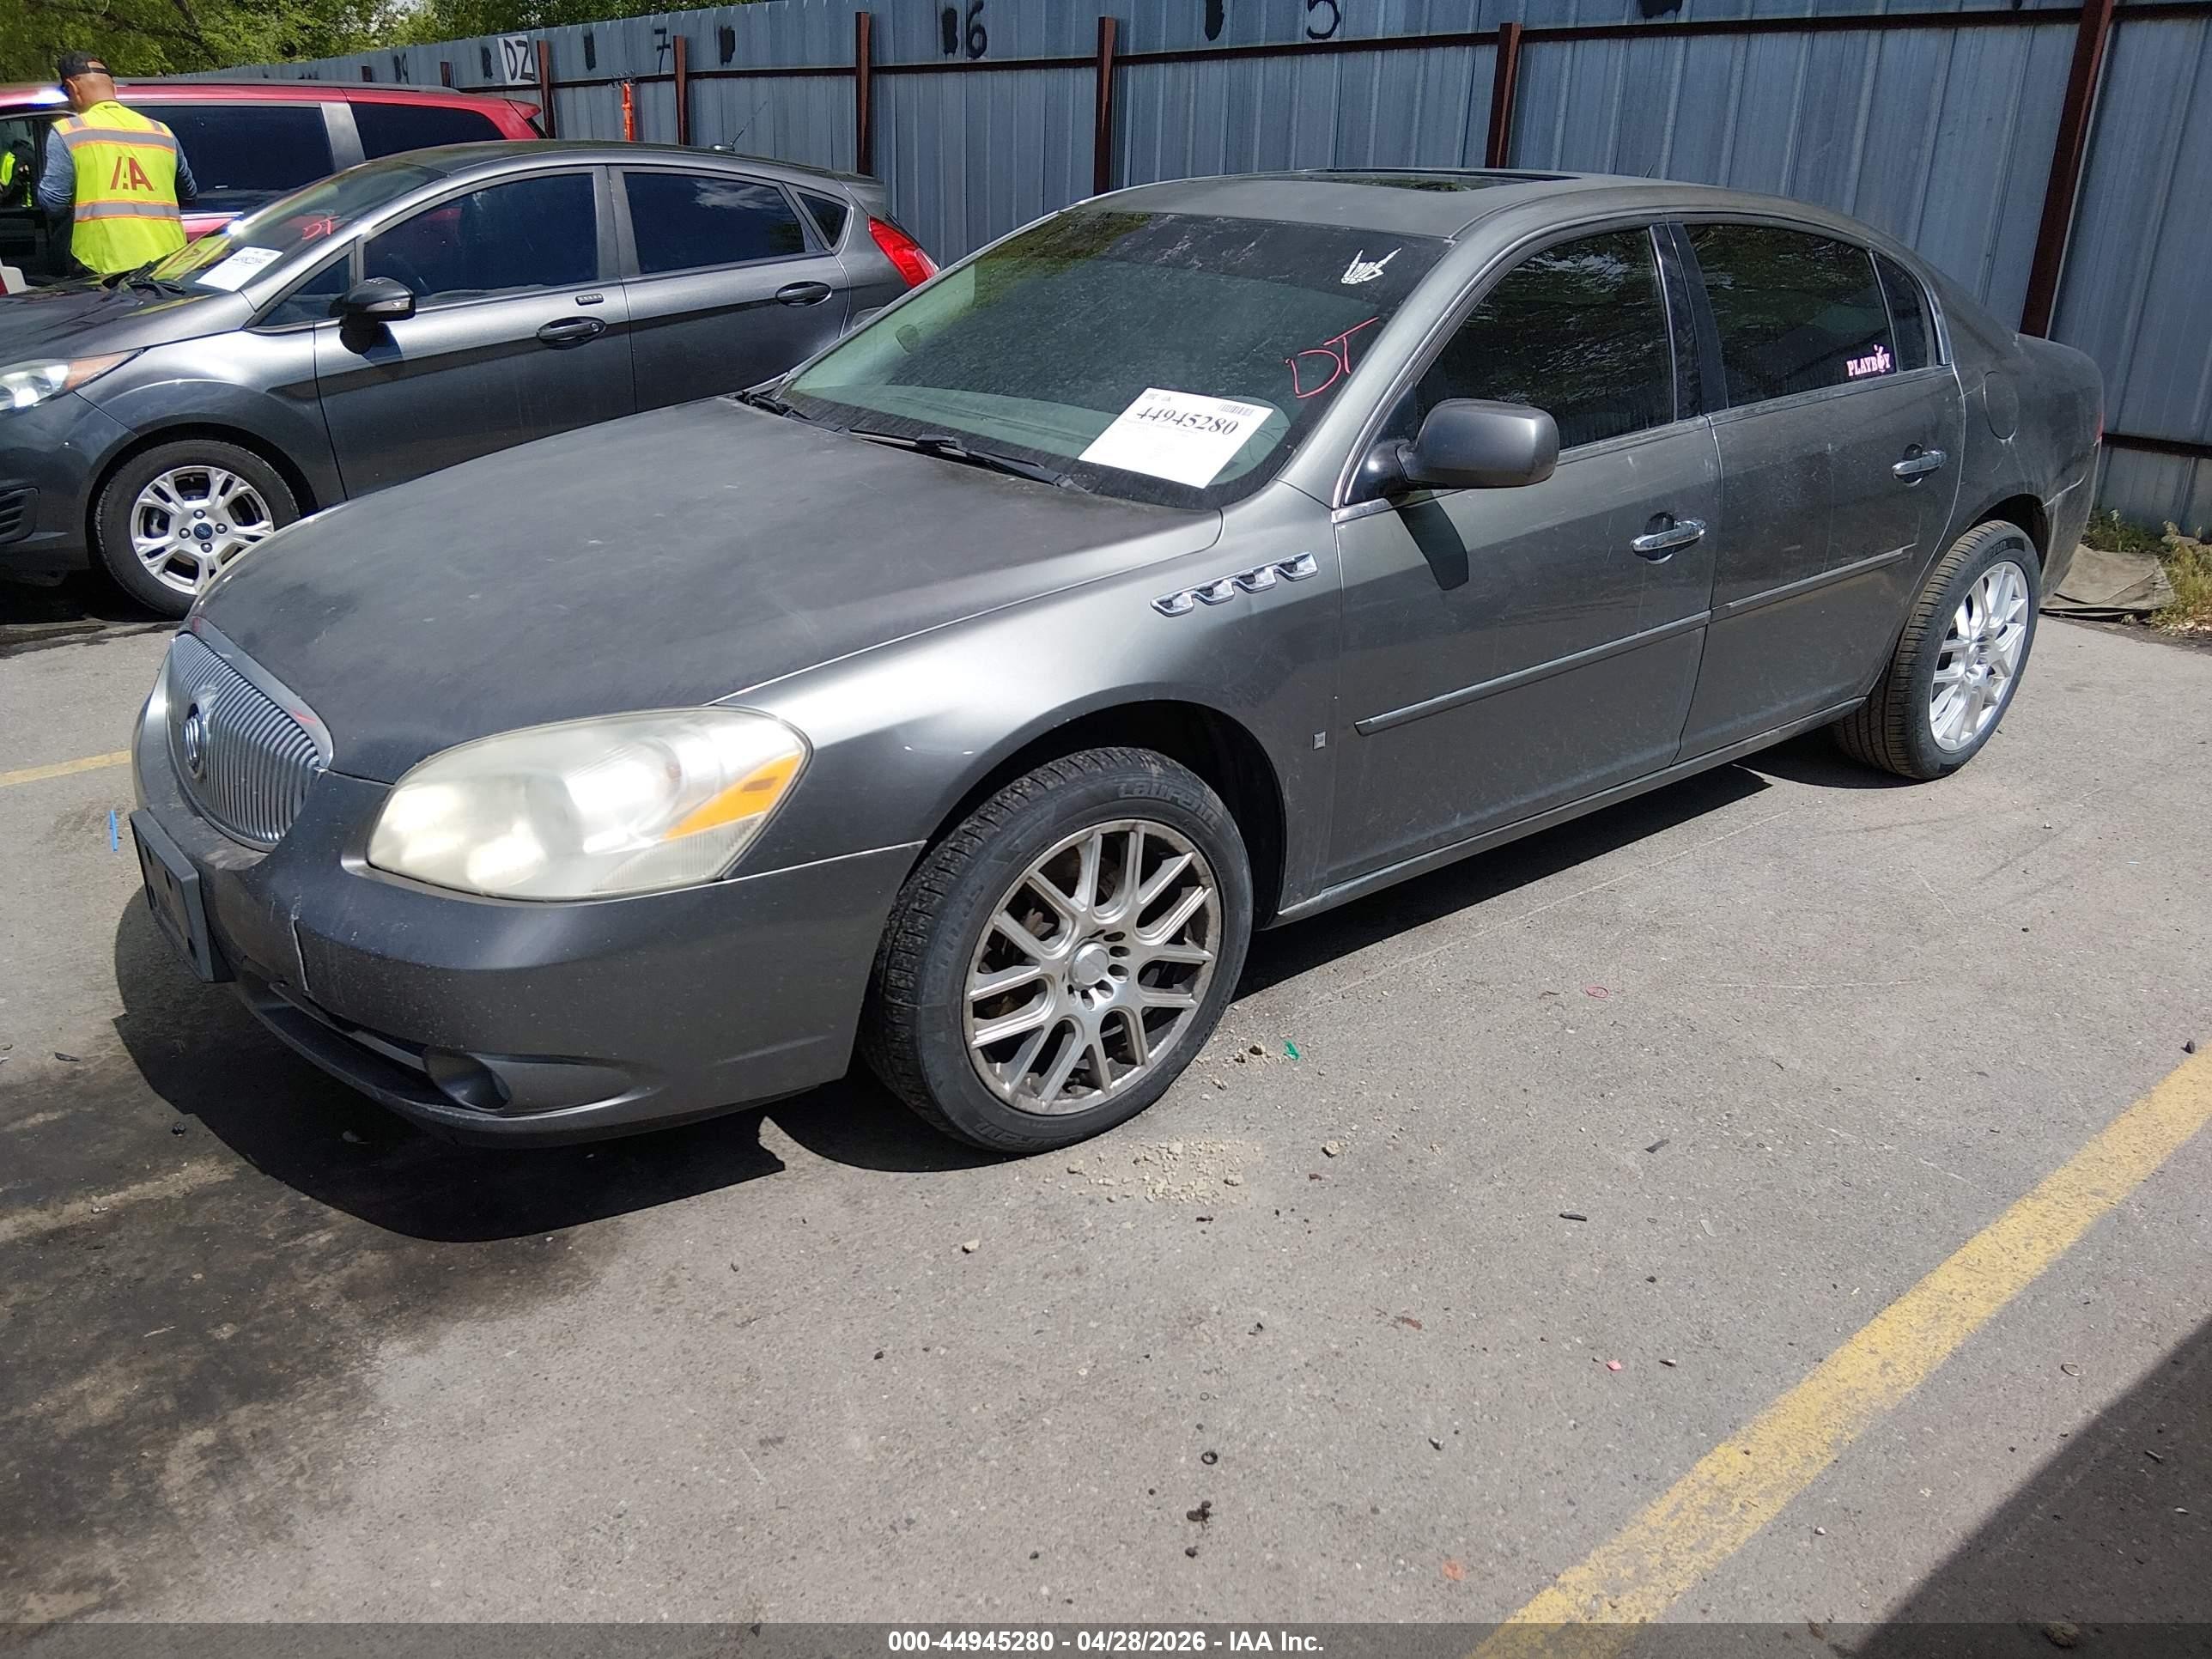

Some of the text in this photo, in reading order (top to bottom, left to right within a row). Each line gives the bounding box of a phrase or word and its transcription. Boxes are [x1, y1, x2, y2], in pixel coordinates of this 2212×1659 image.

[654, 27, 672, 76] 7
[965, 0, 988, 60] 6
[1285, 316, 1379, 398] DT
[1846, 344, 1891, 377] PLAYBOY
[1136, 406, 1239, 435] 44945280
